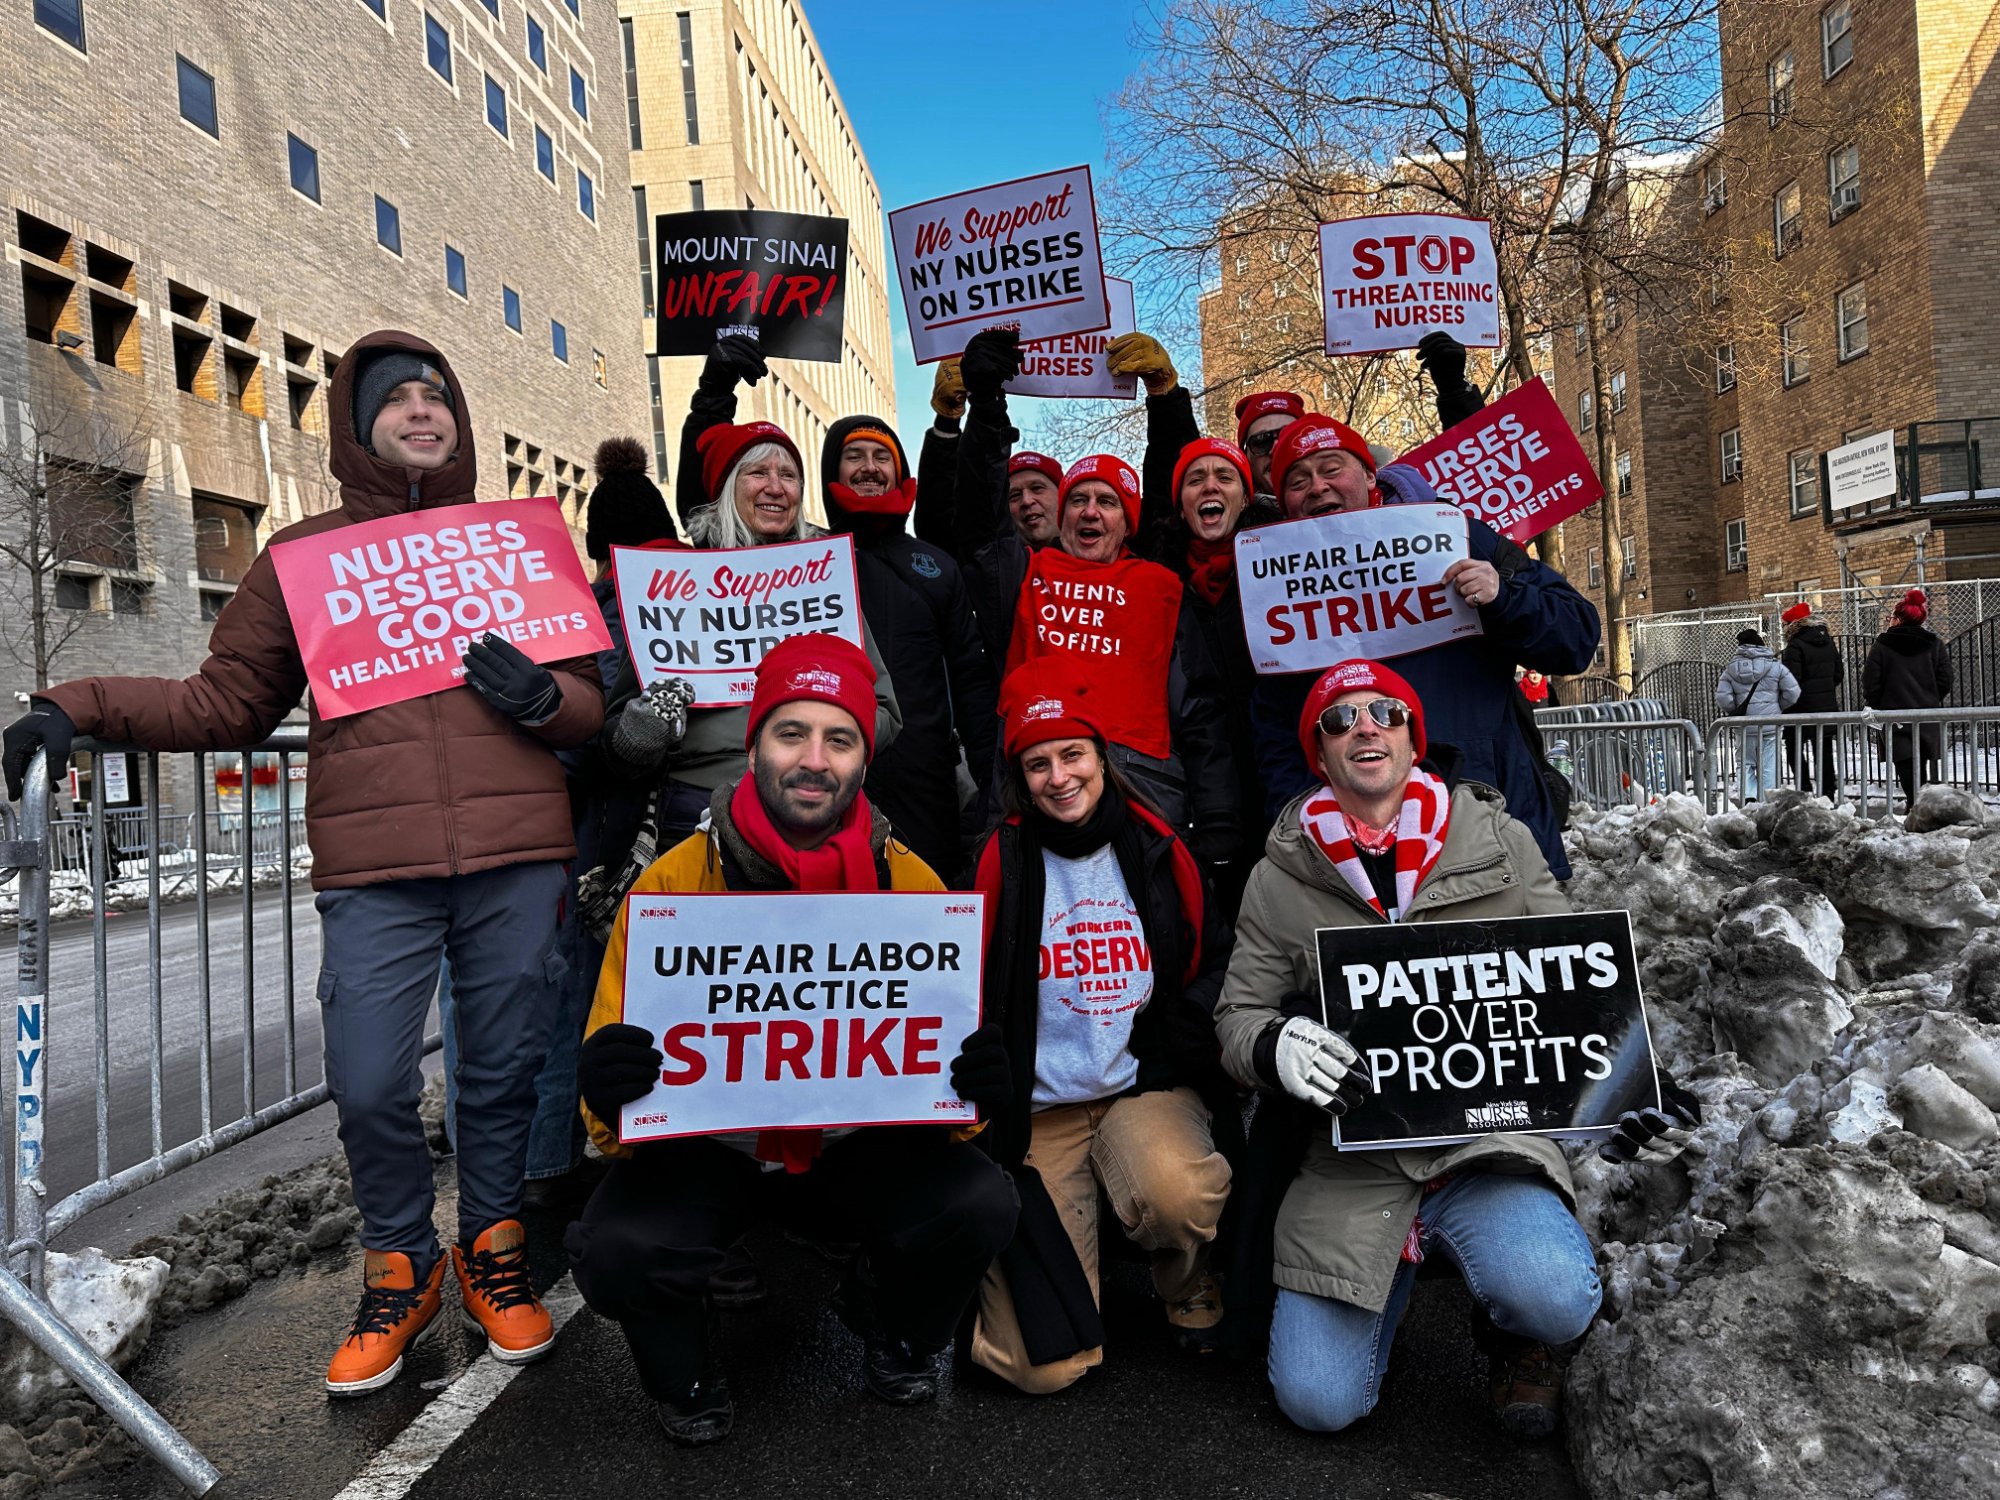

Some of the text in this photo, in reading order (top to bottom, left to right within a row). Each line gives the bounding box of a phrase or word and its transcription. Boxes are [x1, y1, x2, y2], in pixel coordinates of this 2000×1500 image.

[915, 183, 1074, 259] We Support
[664, 236, 837, 269] MOUNT SINAI
[911, 231, 1084, 291] NY NURSES
[665, 270, 838, 319] UNFAIR!
[920, 266, 1083, 320] ON STRIKE
[1332, 281, 1493, 309] THREATENING
[1374, 304, 1465, 329] NURSES
[1020, 357, 1094, 376] URSES
[1417, 412, 1525, 489] URSES
[1436, 430, 1551, 505] SERVE
[328, 520, 527, 586] NURSES
[1251, 533, 1453, 580] UNFAIR LABOR
[324, 550, 554, 626] DESERVE
[647, 549, 836, 606] We Support
[1285, 561, 1418, 599] PRACTICE
[377, 589, 526, 649] GOOD
[638, 593, 844, 632] NY NURSES
[1040, 604, 1105, 628] OVER
[1265, 583, 1453, 646] STRIKE
[329, 641, 446, 690] HEALTH
[648, 638, 700, 665] ON
[1066, 919, 1133, 937] WORKERS
[655, 941, 961, 977] UNFAIR LABOR
[1038, 936, 1153, 981] DESERV
[1342, 941, 1619, 1010] PATIENTS
[708, 979, 909, 1014] PRACTICE
[1411, 999, 1543, 1044] OVER
[662, 1016, 943, 1086] STRIKE
[1366, 1033, 1613, 1094] PROFITS
[16, 1002, 42, 1178] NYPD
[1465, 1105, 1530, 1123] NURSES
[1467, 1118, 1533, 1129] ASSOCIATION
